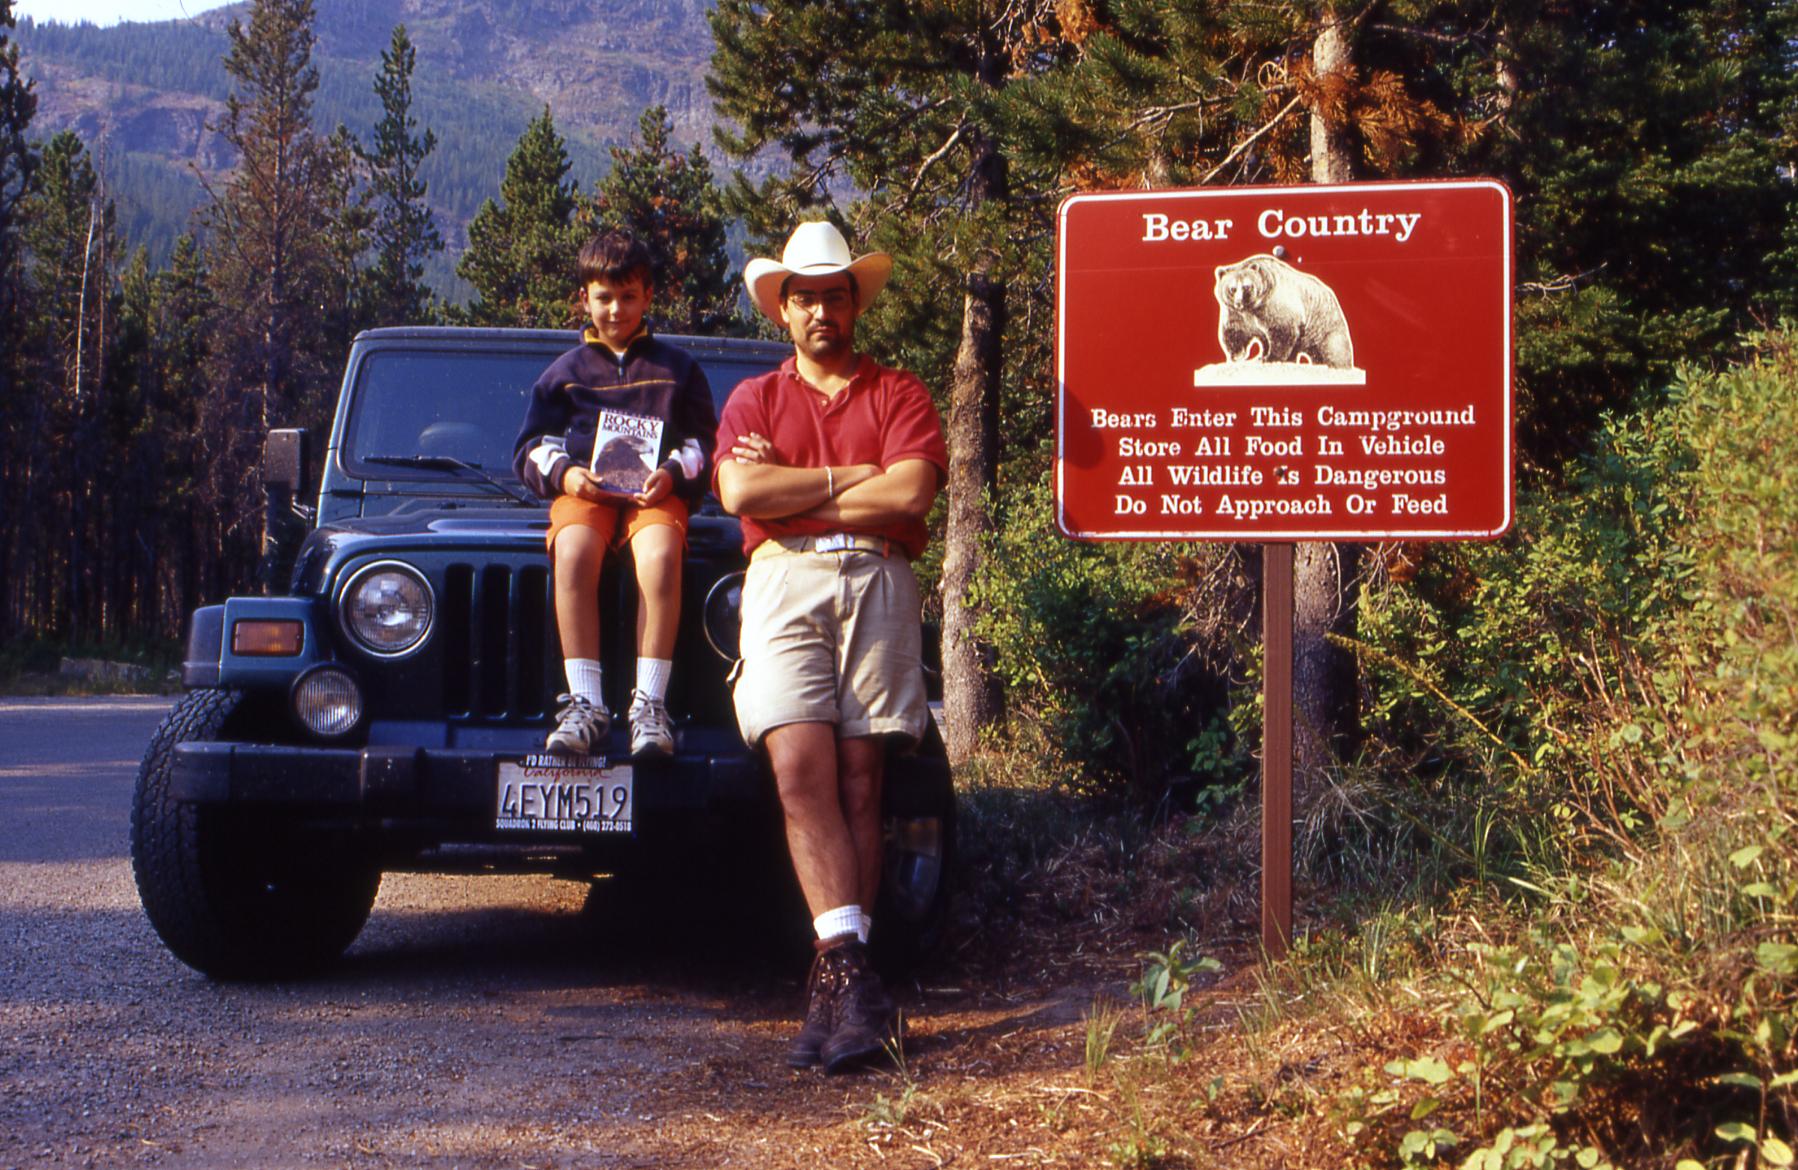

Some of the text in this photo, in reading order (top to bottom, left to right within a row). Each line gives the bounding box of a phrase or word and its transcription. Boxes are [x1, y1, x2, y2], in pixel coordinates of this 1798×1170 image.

[1142, 208, 1421, 242] Bear Country
[605, 413, 659, 432] ROCKY
[1091, 405, 1476, 431] Bears Enter This Campground
[602, 424, 658, 439] MOUNTAINS
[1119, 435, 1445, 457] Store All Food In Vehicle
[1118, 465, 1446, 490] All Wildlife Is Dangerous
[1115, 494, 1448, 520] Do Not Approach Or Feed
[501, 783, 628, 819] 4EYM519
[496, 818, 530, 829] SQUADRON
[531, 819, 536, 830] 2
[537, 819, 559, 830] FLYING
[560, 819, 576, 831] CLUB
